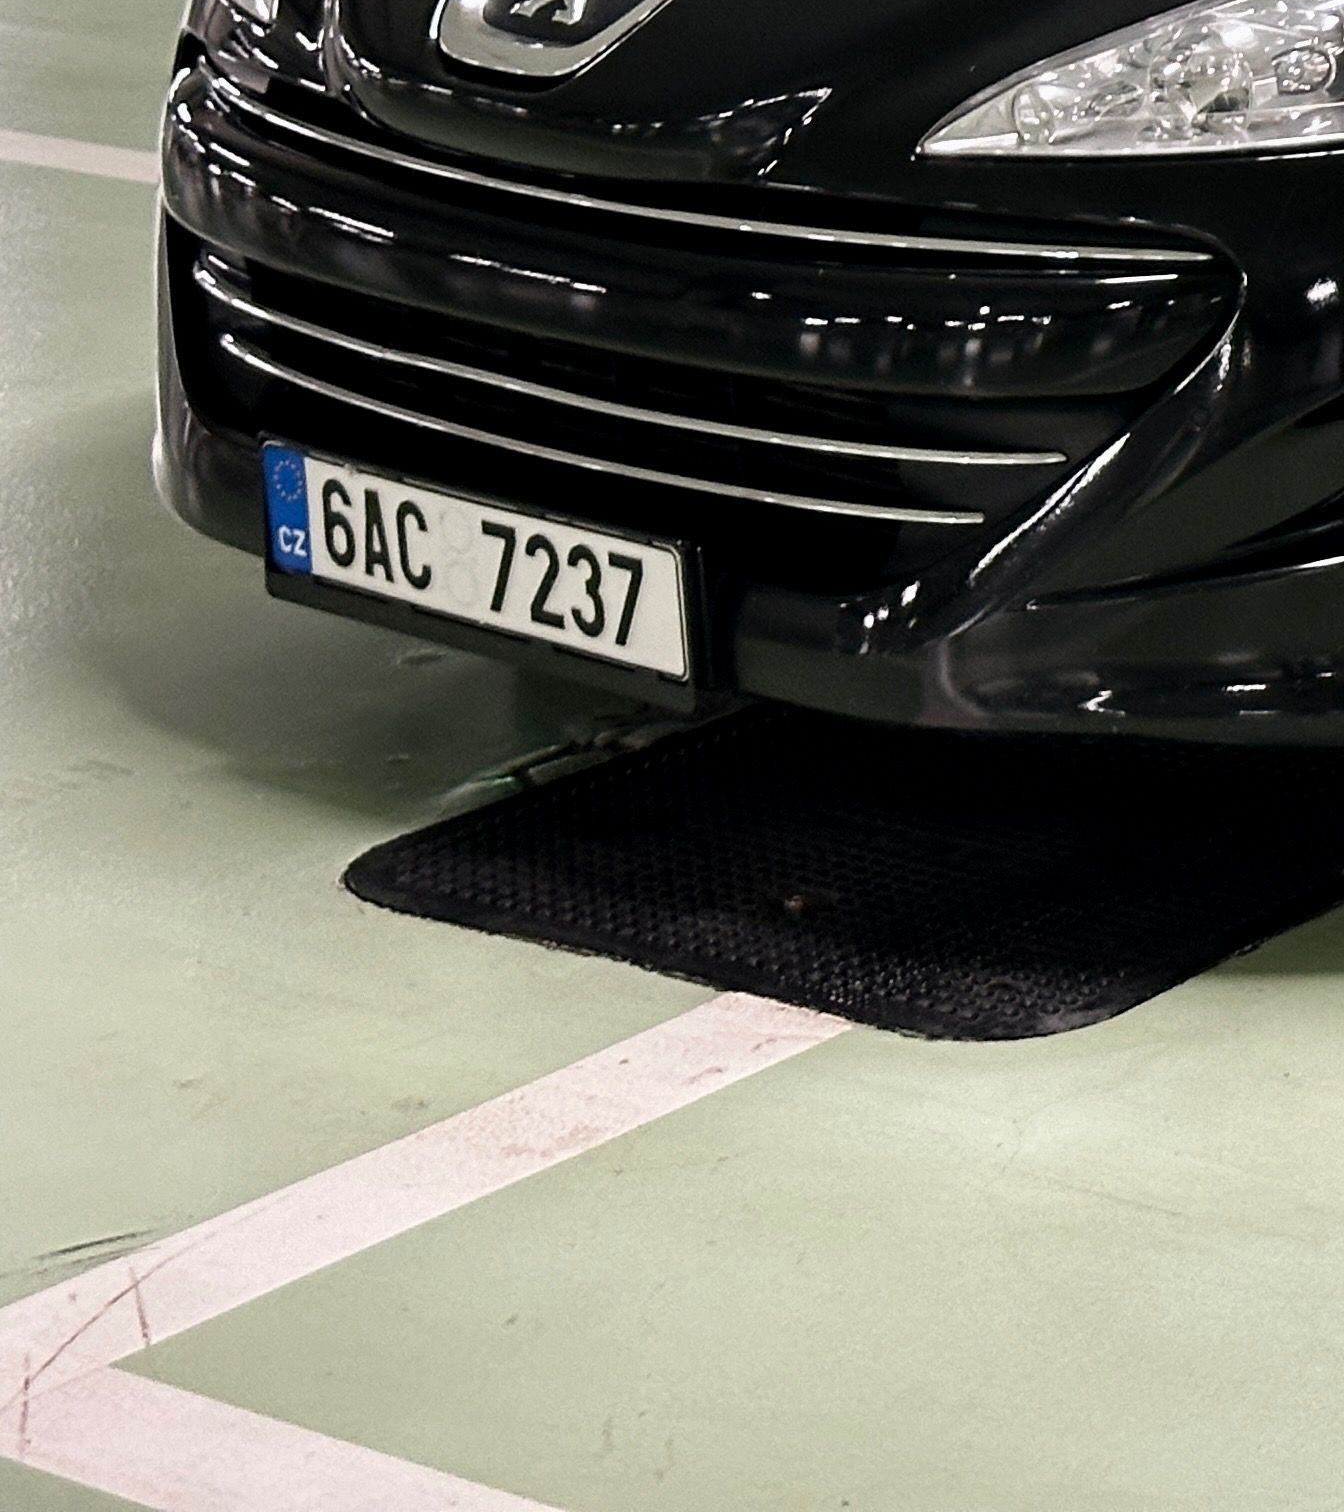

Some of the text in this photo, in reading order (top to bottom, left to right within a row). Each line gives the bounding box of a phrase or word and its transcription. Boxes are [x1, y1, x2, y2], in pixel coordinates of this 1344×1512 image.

[278, 478, 643, 646] CZ 6AC 7237
